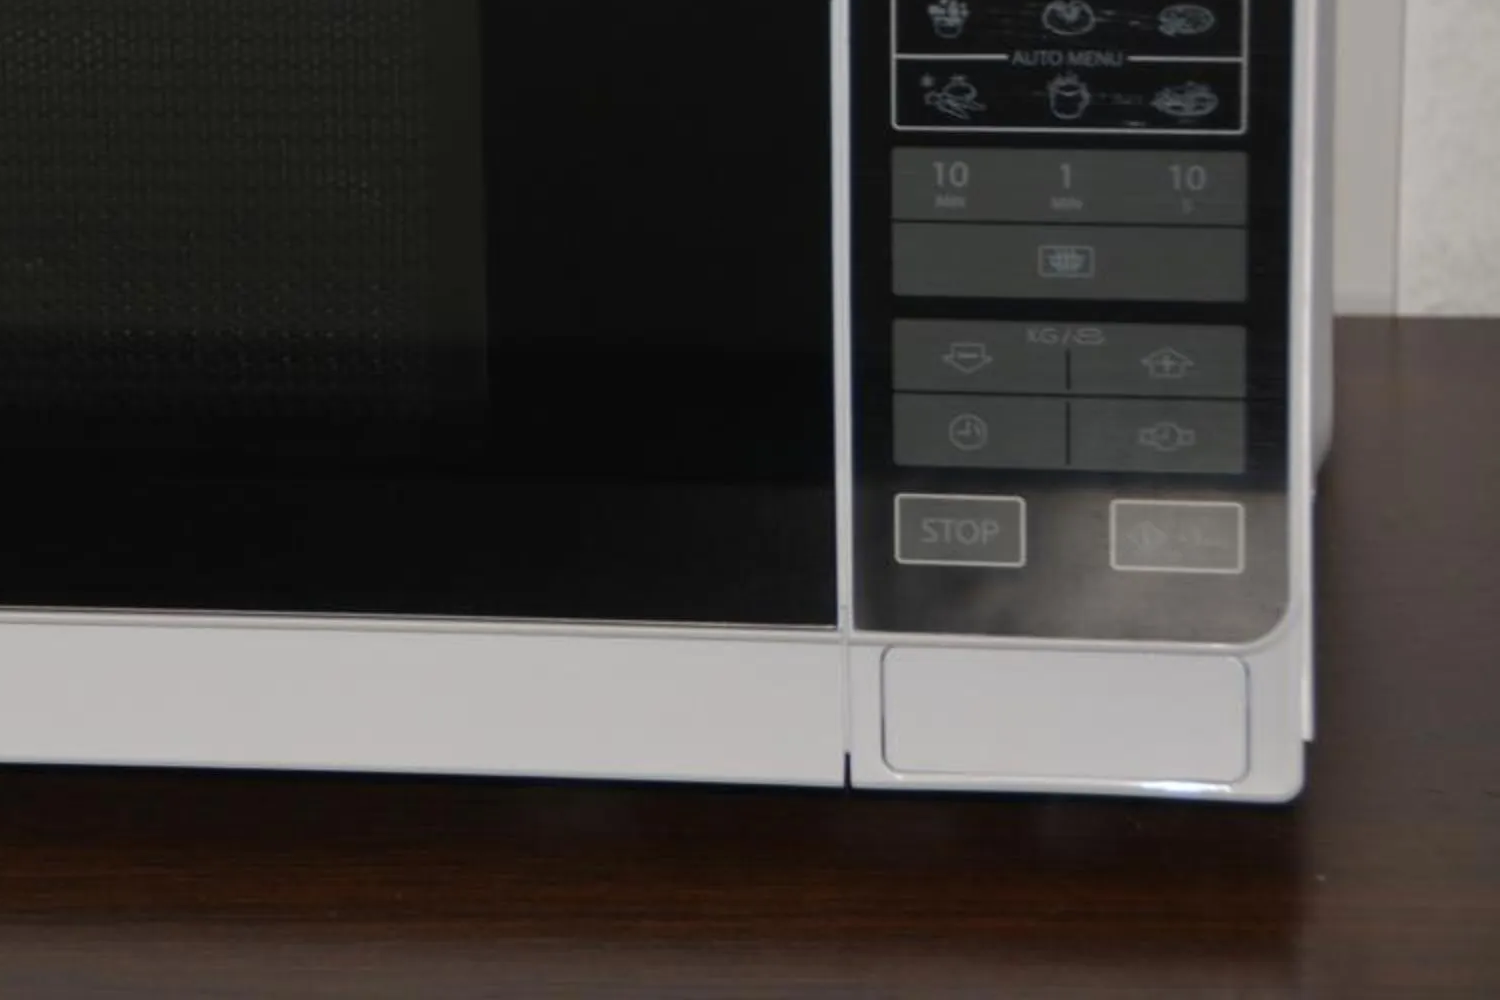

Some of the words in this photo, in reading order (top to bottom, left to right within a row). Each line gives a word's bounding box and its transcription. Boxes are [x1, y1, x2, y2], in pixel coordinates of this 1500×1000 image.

[1012, 50, 1063, 67] AUTO
[1068, 51, 1124, 68] MENU
[932, 161, 969, 188] 10
[1059, 163, 1071, 189] 1
[1168, 165, 1206, 191] 10
[922, 518, 999, 545] STOP
